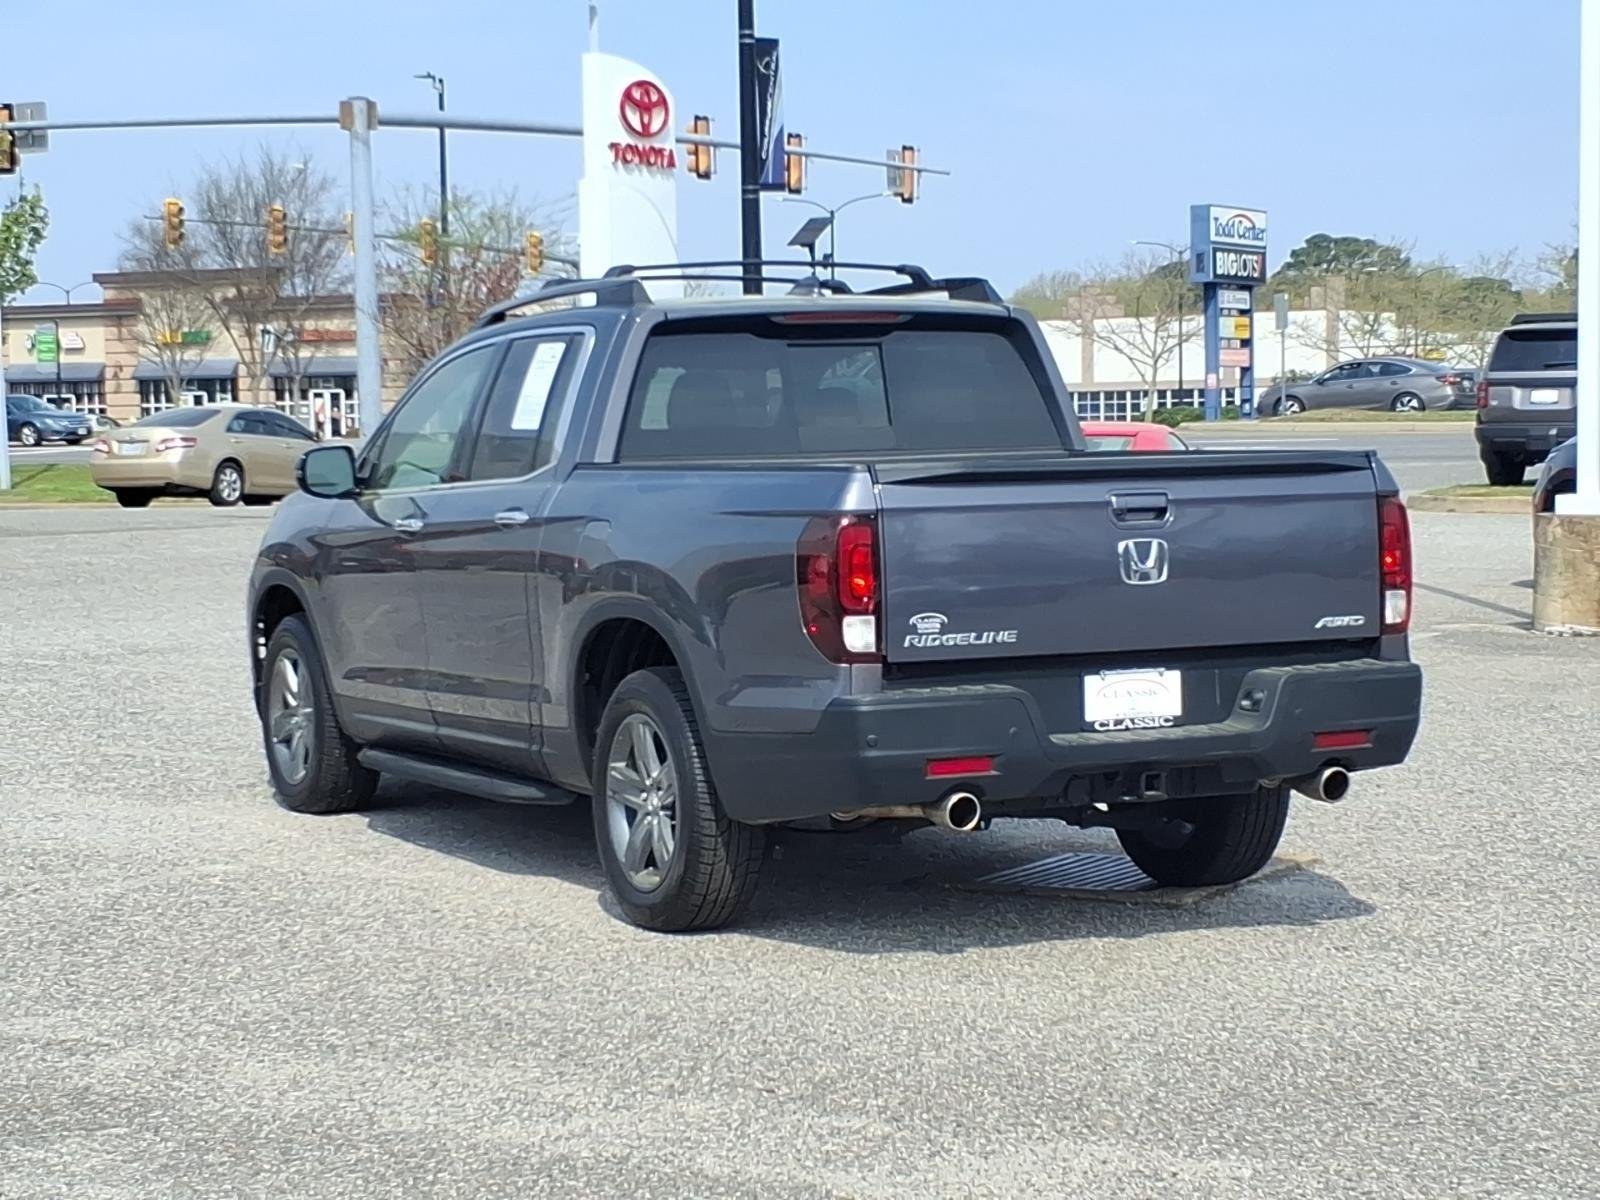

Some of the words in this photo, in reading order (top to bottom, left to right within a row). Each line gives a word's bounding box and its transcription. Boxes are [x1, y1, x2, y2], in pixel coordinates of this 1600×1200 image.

[608, 142, 676, 168] TOYOTA
[1213, 217, 1236, 238] Todd
[1236, 219, 1266, 241] Center
[903, 630, 1018, 648] RIDGELINE
[1094, 715, 1174, 731] CLASSIC
